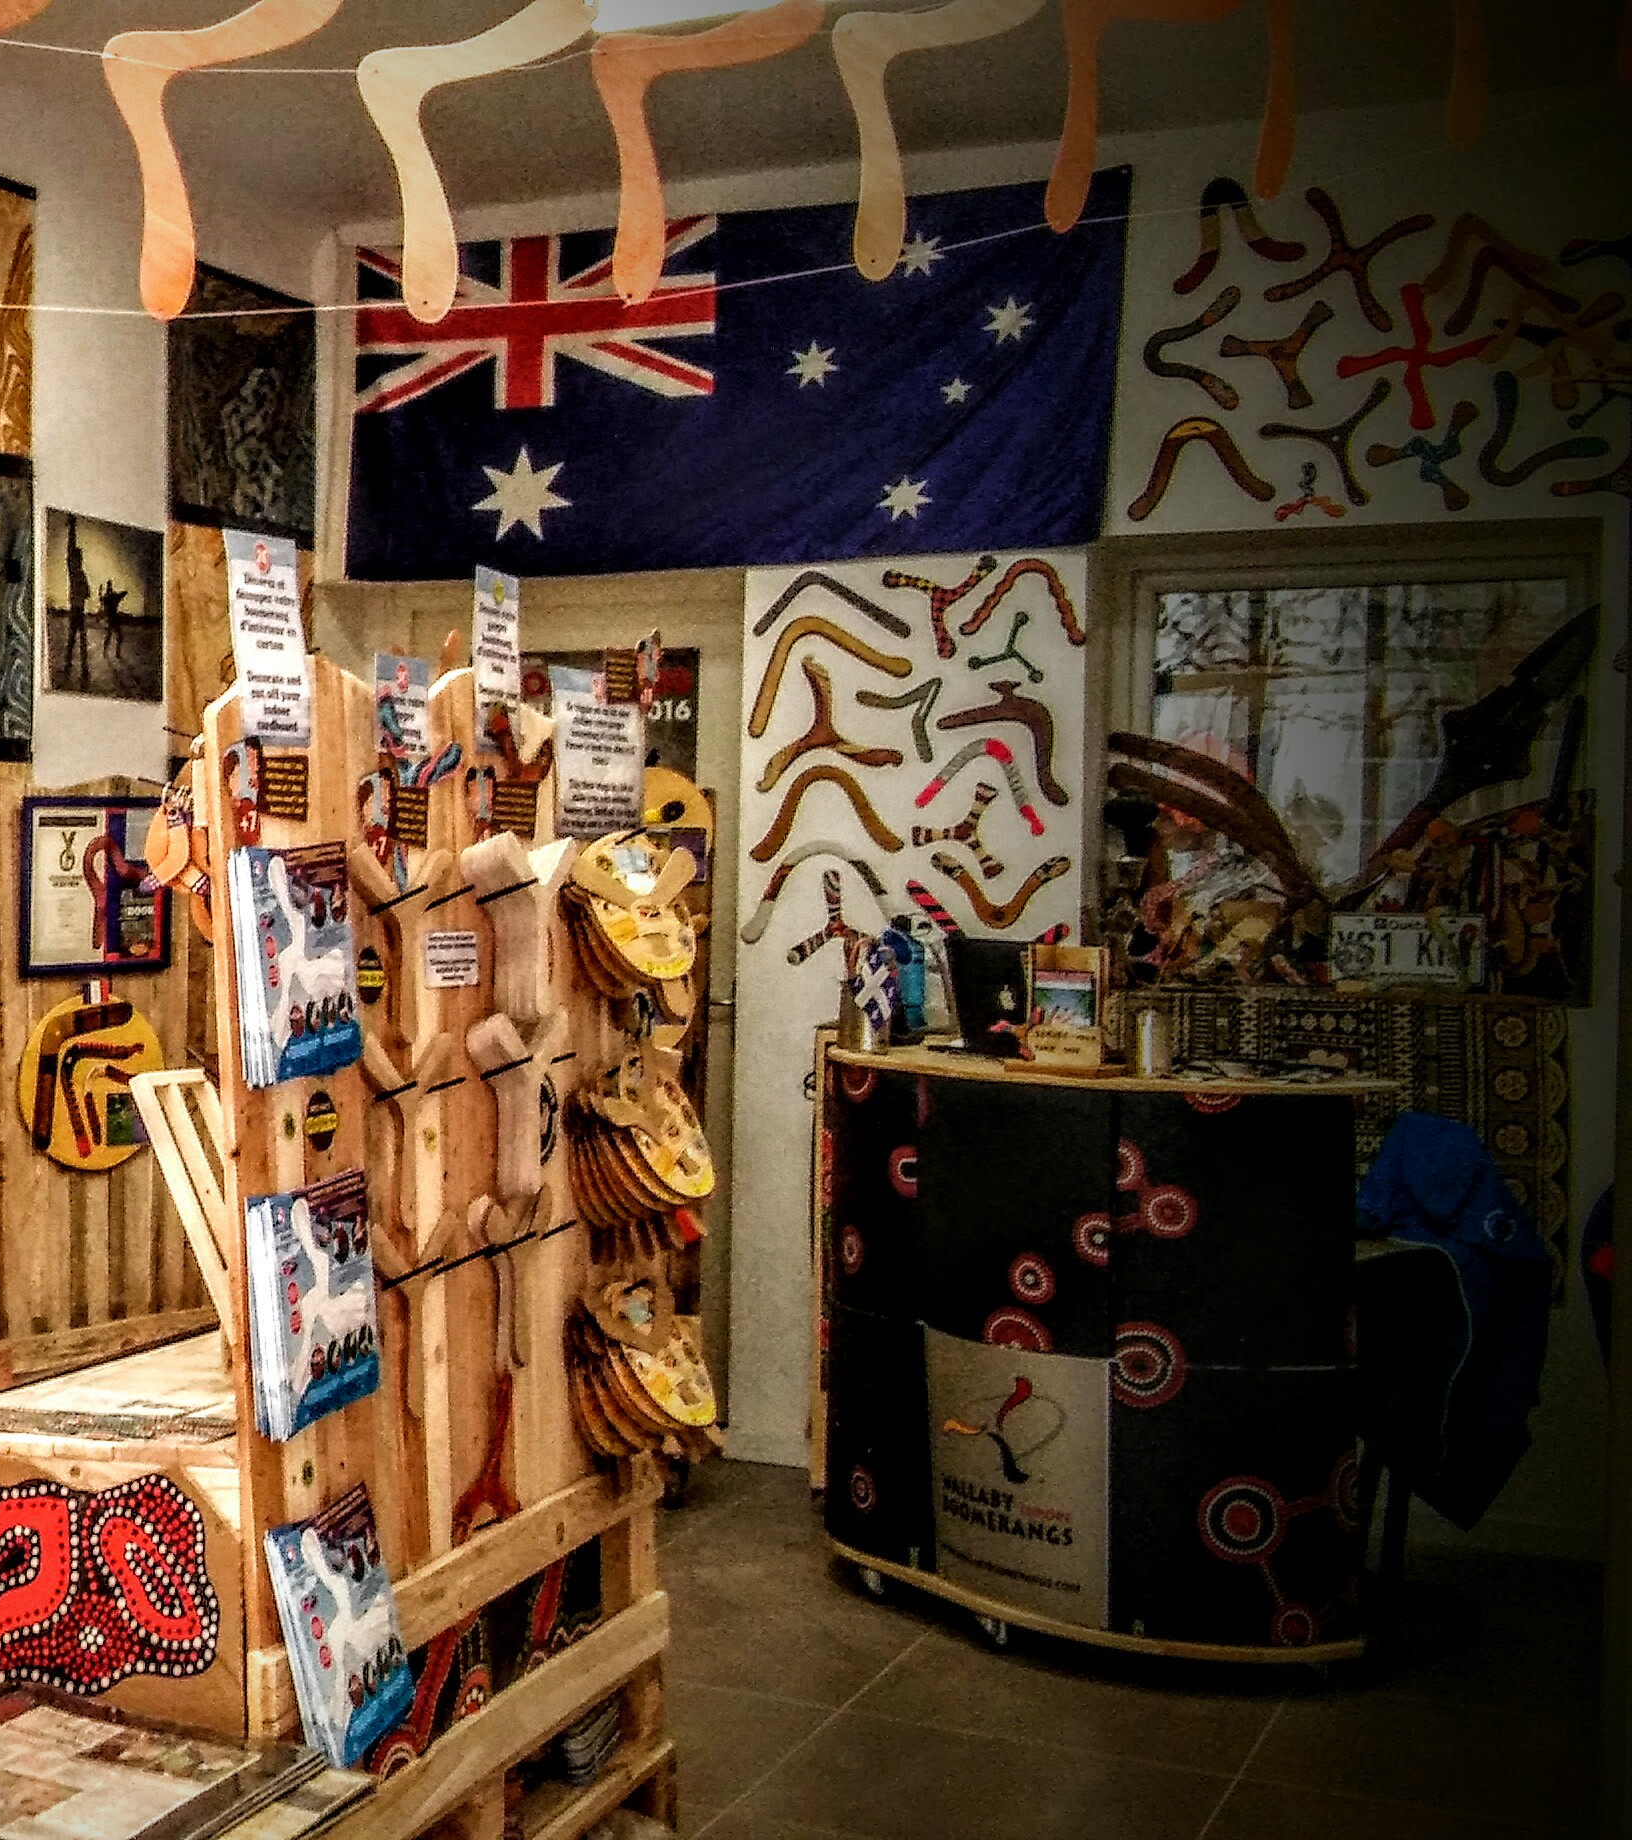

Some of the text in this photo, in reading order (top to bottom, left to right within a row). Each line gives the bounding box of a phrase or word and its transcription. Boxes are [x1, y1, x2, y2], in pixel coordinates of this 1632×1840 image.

[287, 676, 302, 686] and
[941, 1472, 1014, 1512] WALLABY
[942, 1495, 1074, 1547] BOOMERANGS
